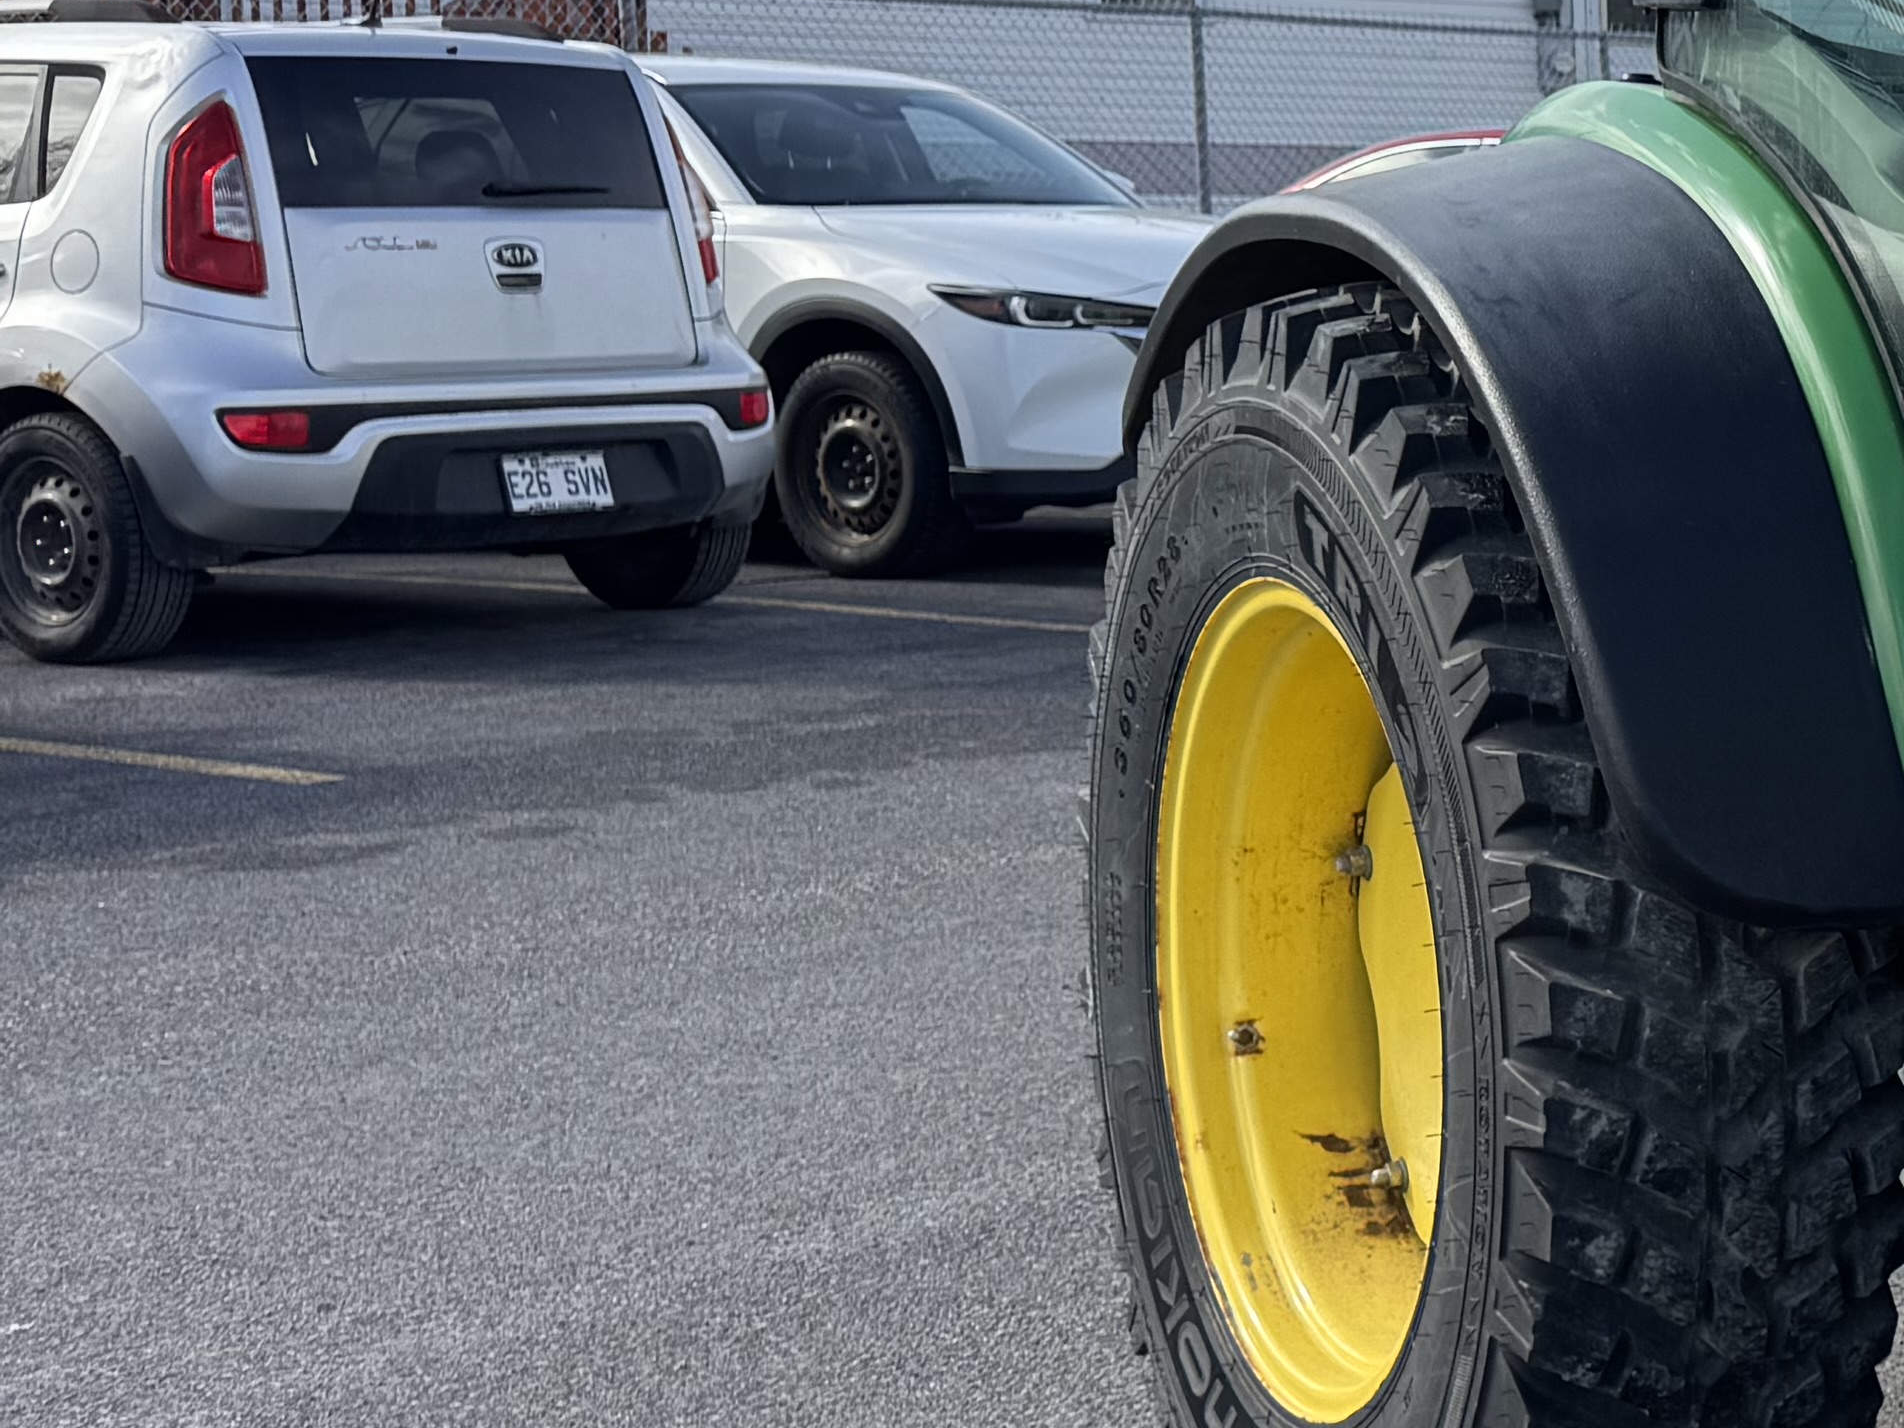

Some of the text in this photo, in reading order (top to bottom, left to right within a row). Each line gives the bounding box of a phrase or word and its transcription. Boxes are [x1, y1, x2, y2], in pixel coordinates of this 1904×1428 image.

[501, 247, 534, 265] KIA
[506, 466, 608, 500] E26 SVN
[1303, 511, 1386, 666] TRI
